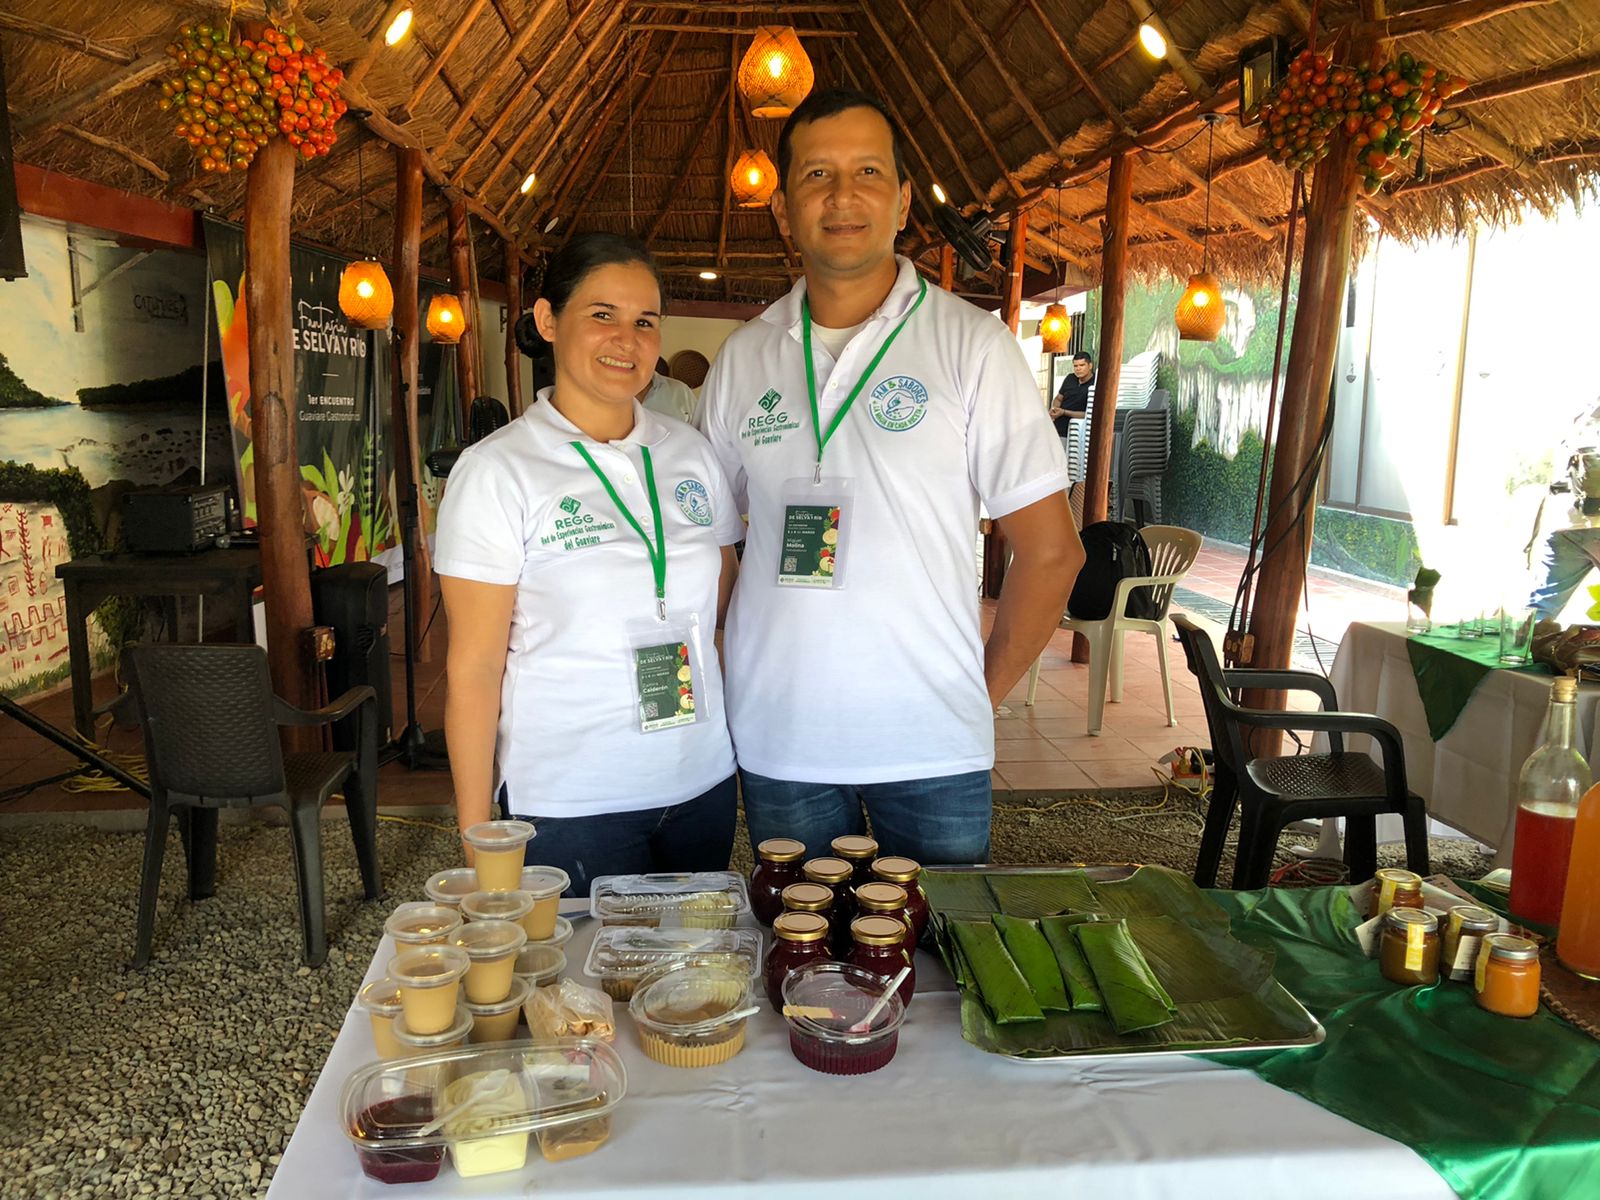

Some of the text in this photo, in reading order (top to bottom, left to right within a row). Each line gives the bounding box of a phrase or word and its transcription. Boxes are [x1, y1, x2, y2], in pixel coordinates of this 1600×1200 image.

[292, 328, 301, 350] E
[303, 329, 341, 355] SELVA
[341, 336, 349, 356] Y
[897, 378, 927, 404] SABORES
[307, 394, 355, 406] 1er ENCUENTRO
[748, 412, 788, 429] REGG
[555, 514, 594, 530] REGG
